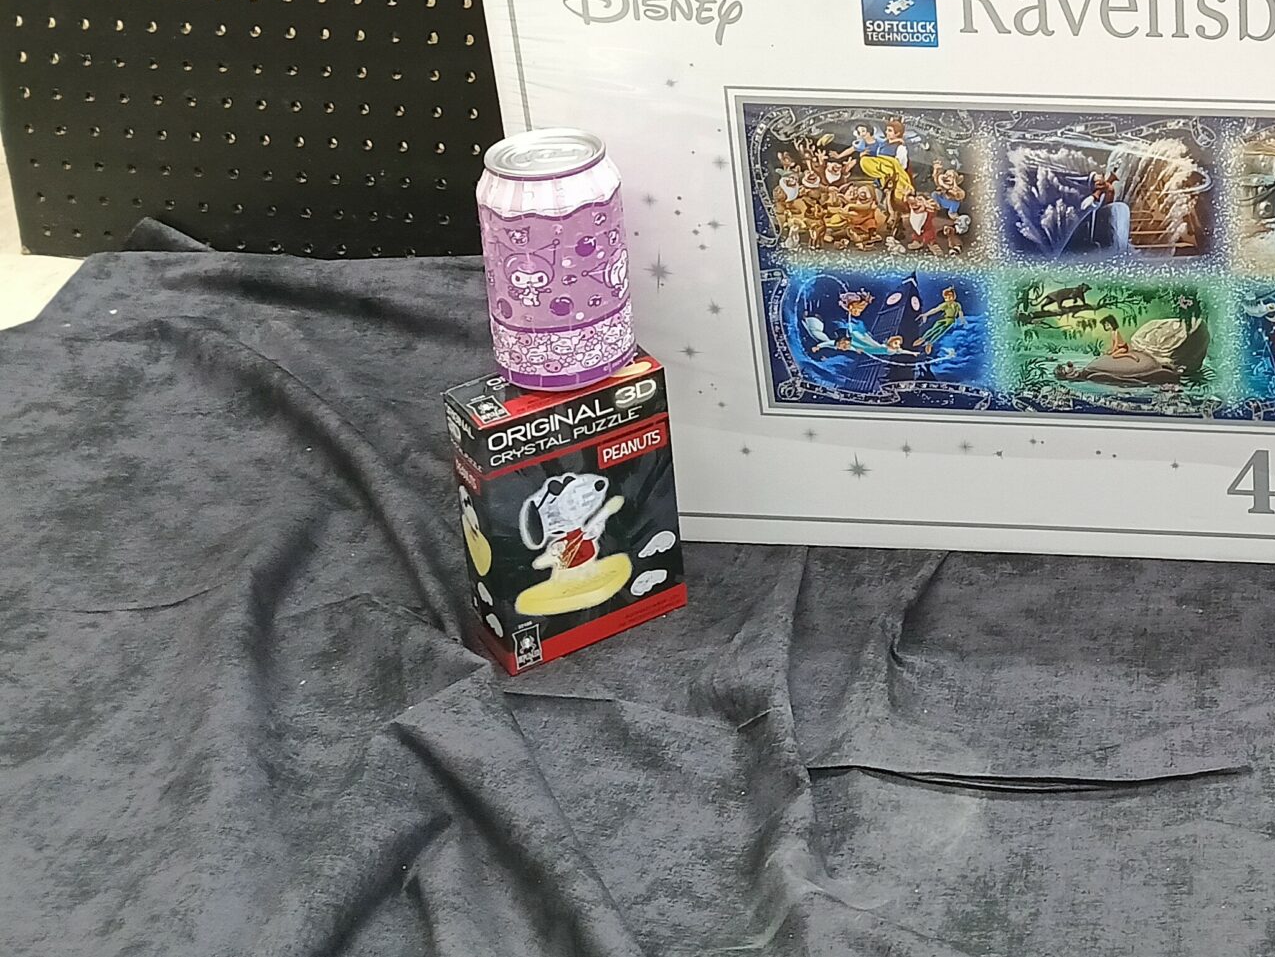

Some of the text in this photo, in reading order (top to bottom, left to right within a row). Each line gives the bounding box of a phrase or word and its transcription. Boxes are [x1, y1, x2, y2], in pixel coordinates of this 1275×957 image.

[865, 20, 937, 35] SOFTCLICK
[867, 31, 937, 43] TECHNOLOGY
[487, 399, 614, 452] ORIGINAL
[614, 379, 657, 407] 3D
[489, 434, 571, 467] CRYSTAL
[573, 408, 641, 439] PUZZLE
[602, 429, 662, 463] PEANUTS
